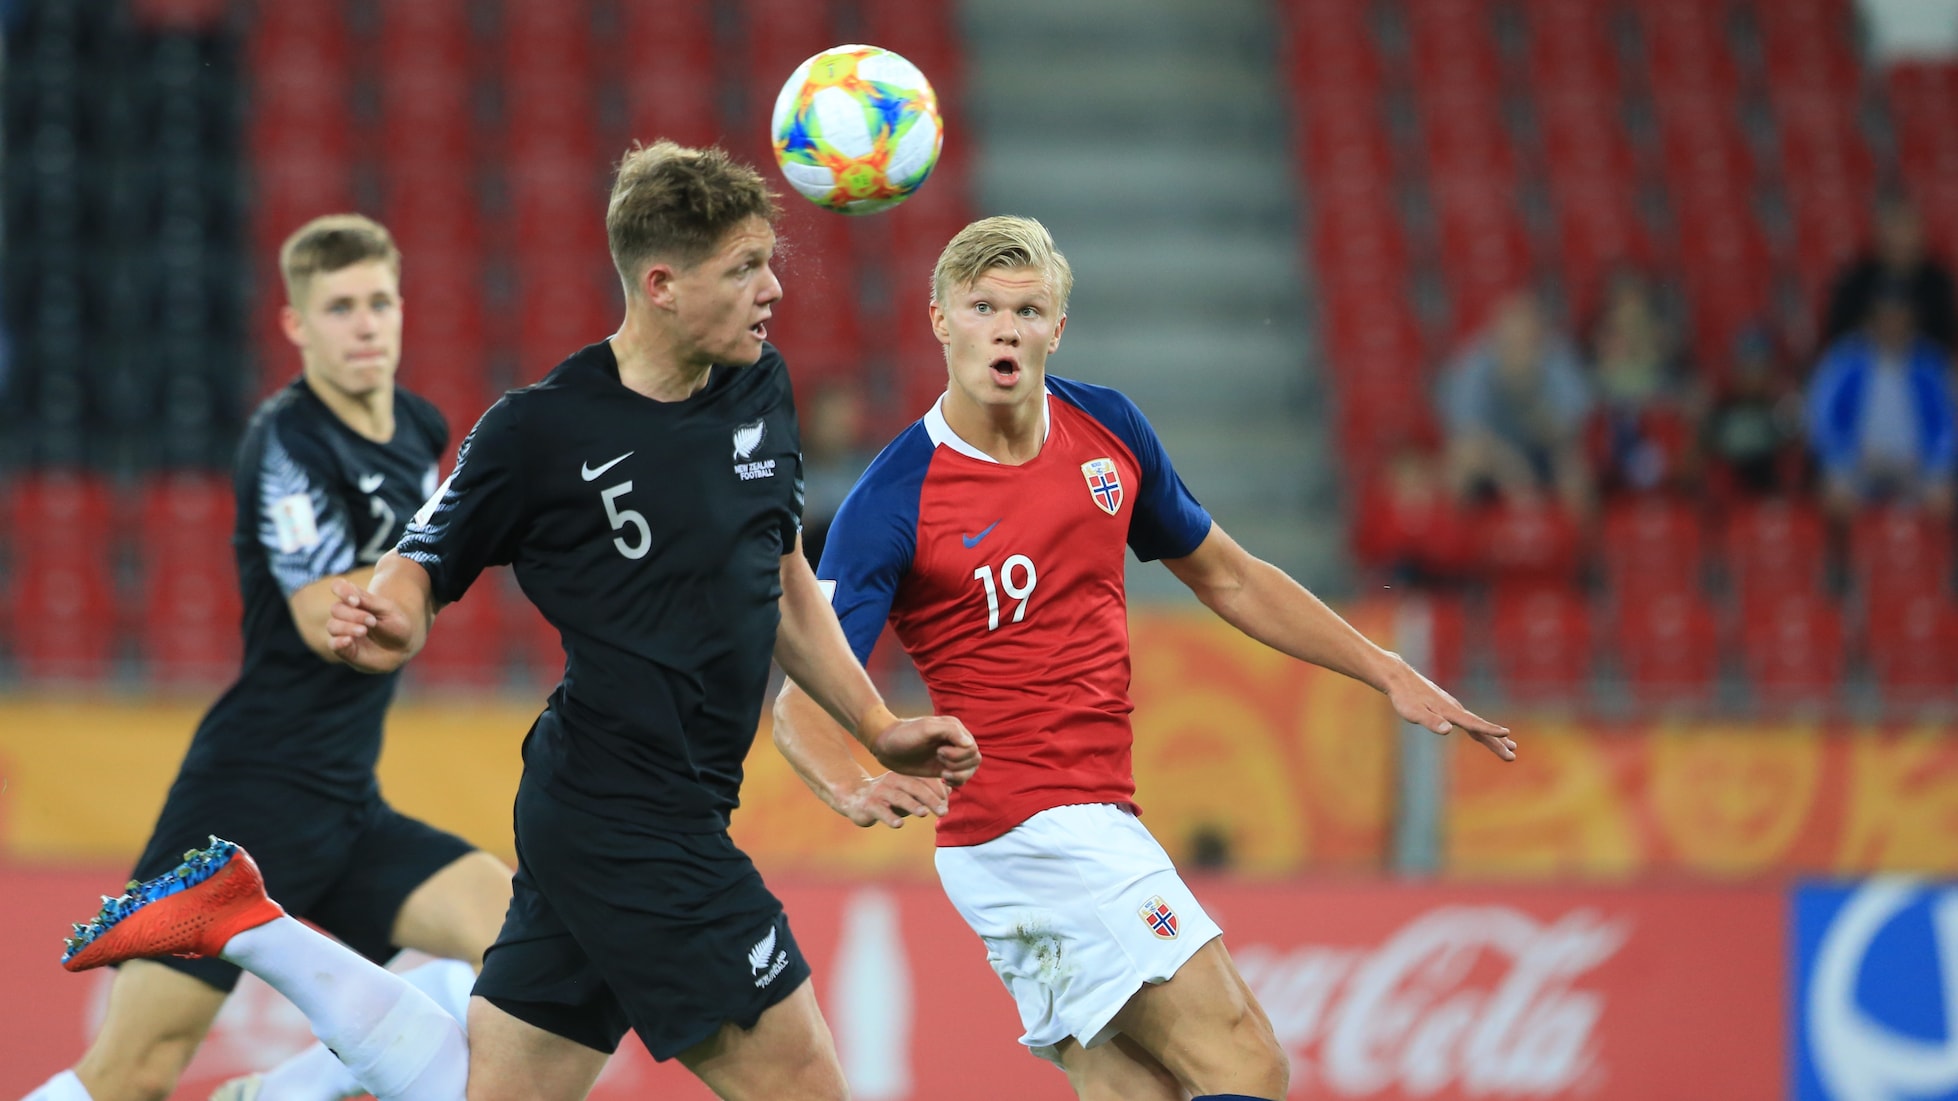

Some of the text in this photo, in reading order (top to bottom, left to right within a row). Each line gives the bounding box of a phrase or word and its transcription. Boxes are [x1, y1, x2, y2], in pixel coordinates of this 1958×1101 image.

[734, 459, 776, 474] NEW ZEALAND
[740, 469, 774, 480] FOOTBALL
[359, 495, 396, 561] 2
[600, 480, 652, 560] 5
[974, 554, 1037, 631] 19
